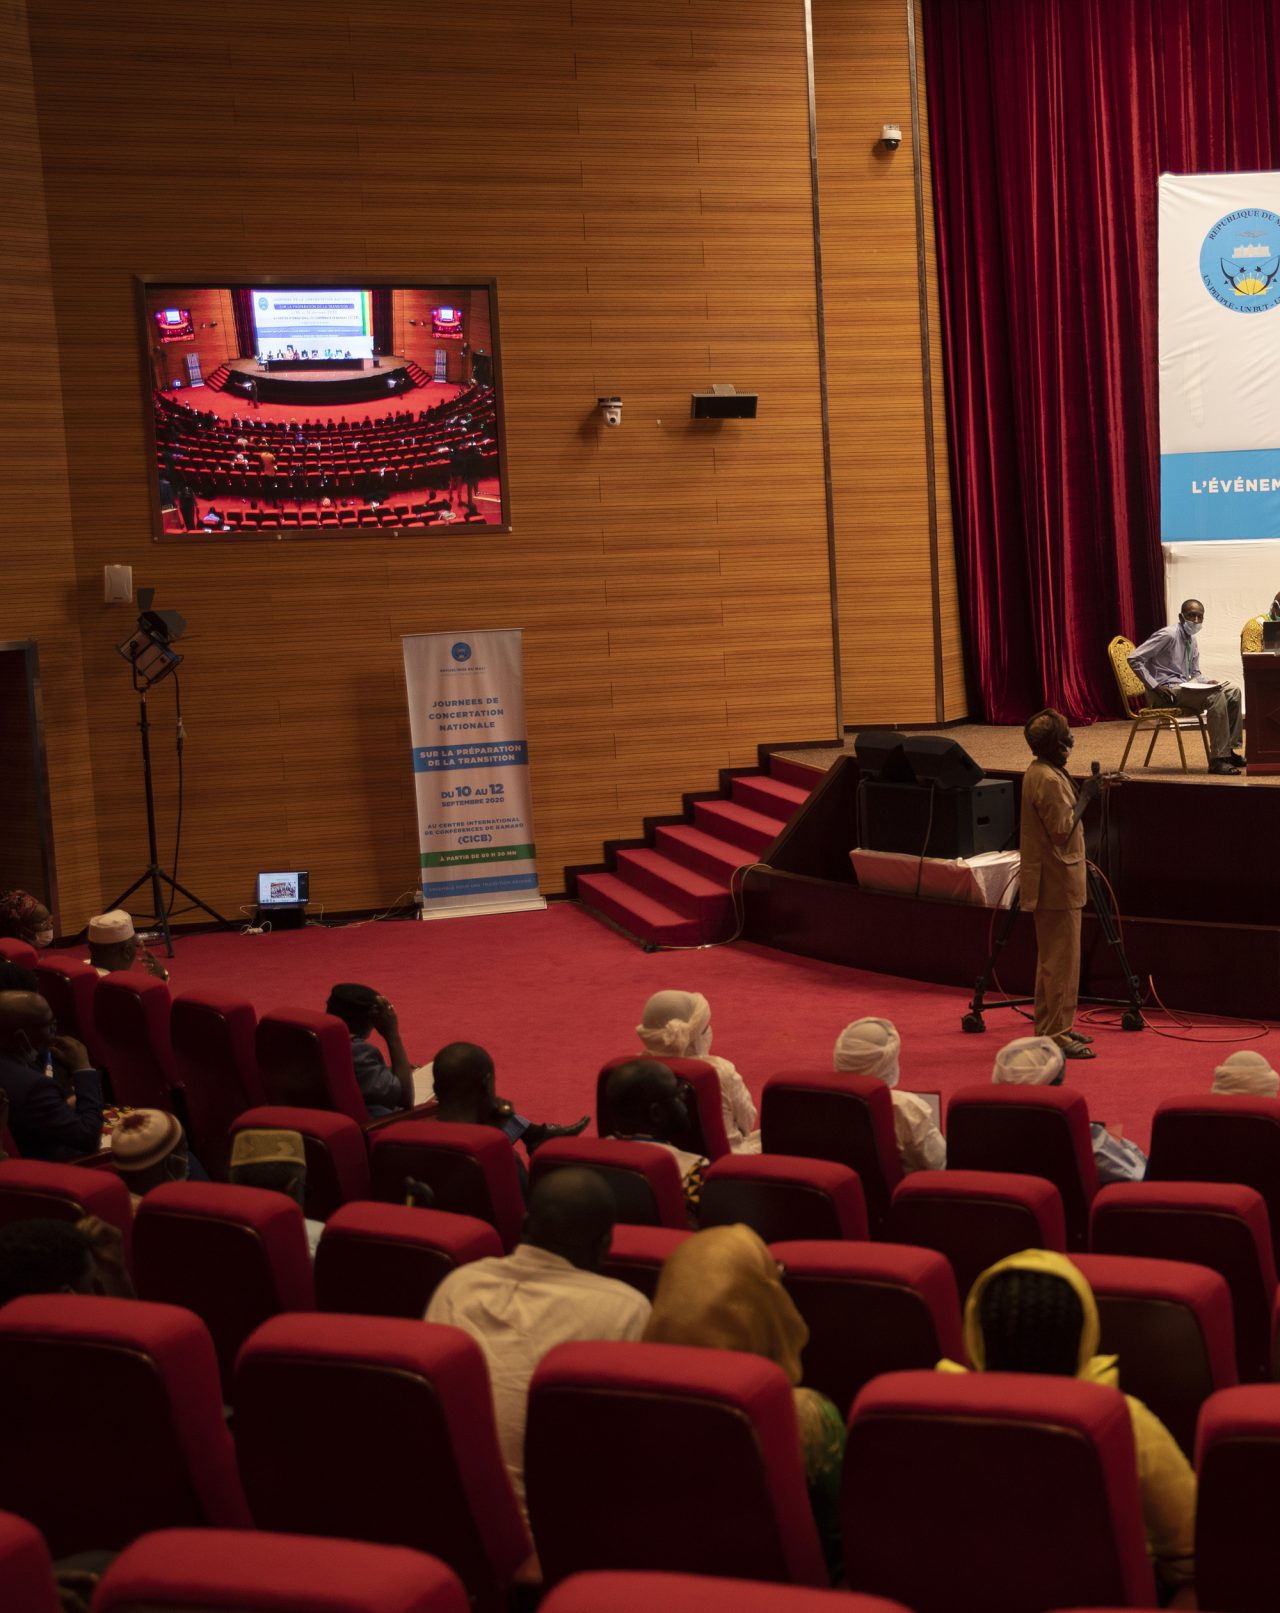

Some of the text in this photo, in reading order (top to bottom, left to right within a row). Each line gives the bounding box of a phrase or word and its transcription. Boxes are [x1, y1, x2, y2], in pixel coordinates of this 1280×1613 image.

[1209, 211, 1260, 240] REPUBLIQUE
[1262, 211, 1275, 221] DU
[432, 699, 483, 707] JOURNEES
[429, 709, 504, 719] CONCERTATION
[440, 722, 495, 731] NATIONALE
[457, 745, 521, 755] PRÉPARATION
[458, 755, 515, 764] TRANSITION
[456, 786, 472, 797] 10
[490, 784, 504, 795] 12
[442, 799, 483, 807] SEPTEMBRE
[458, 834, 492, 844] (CICB)
